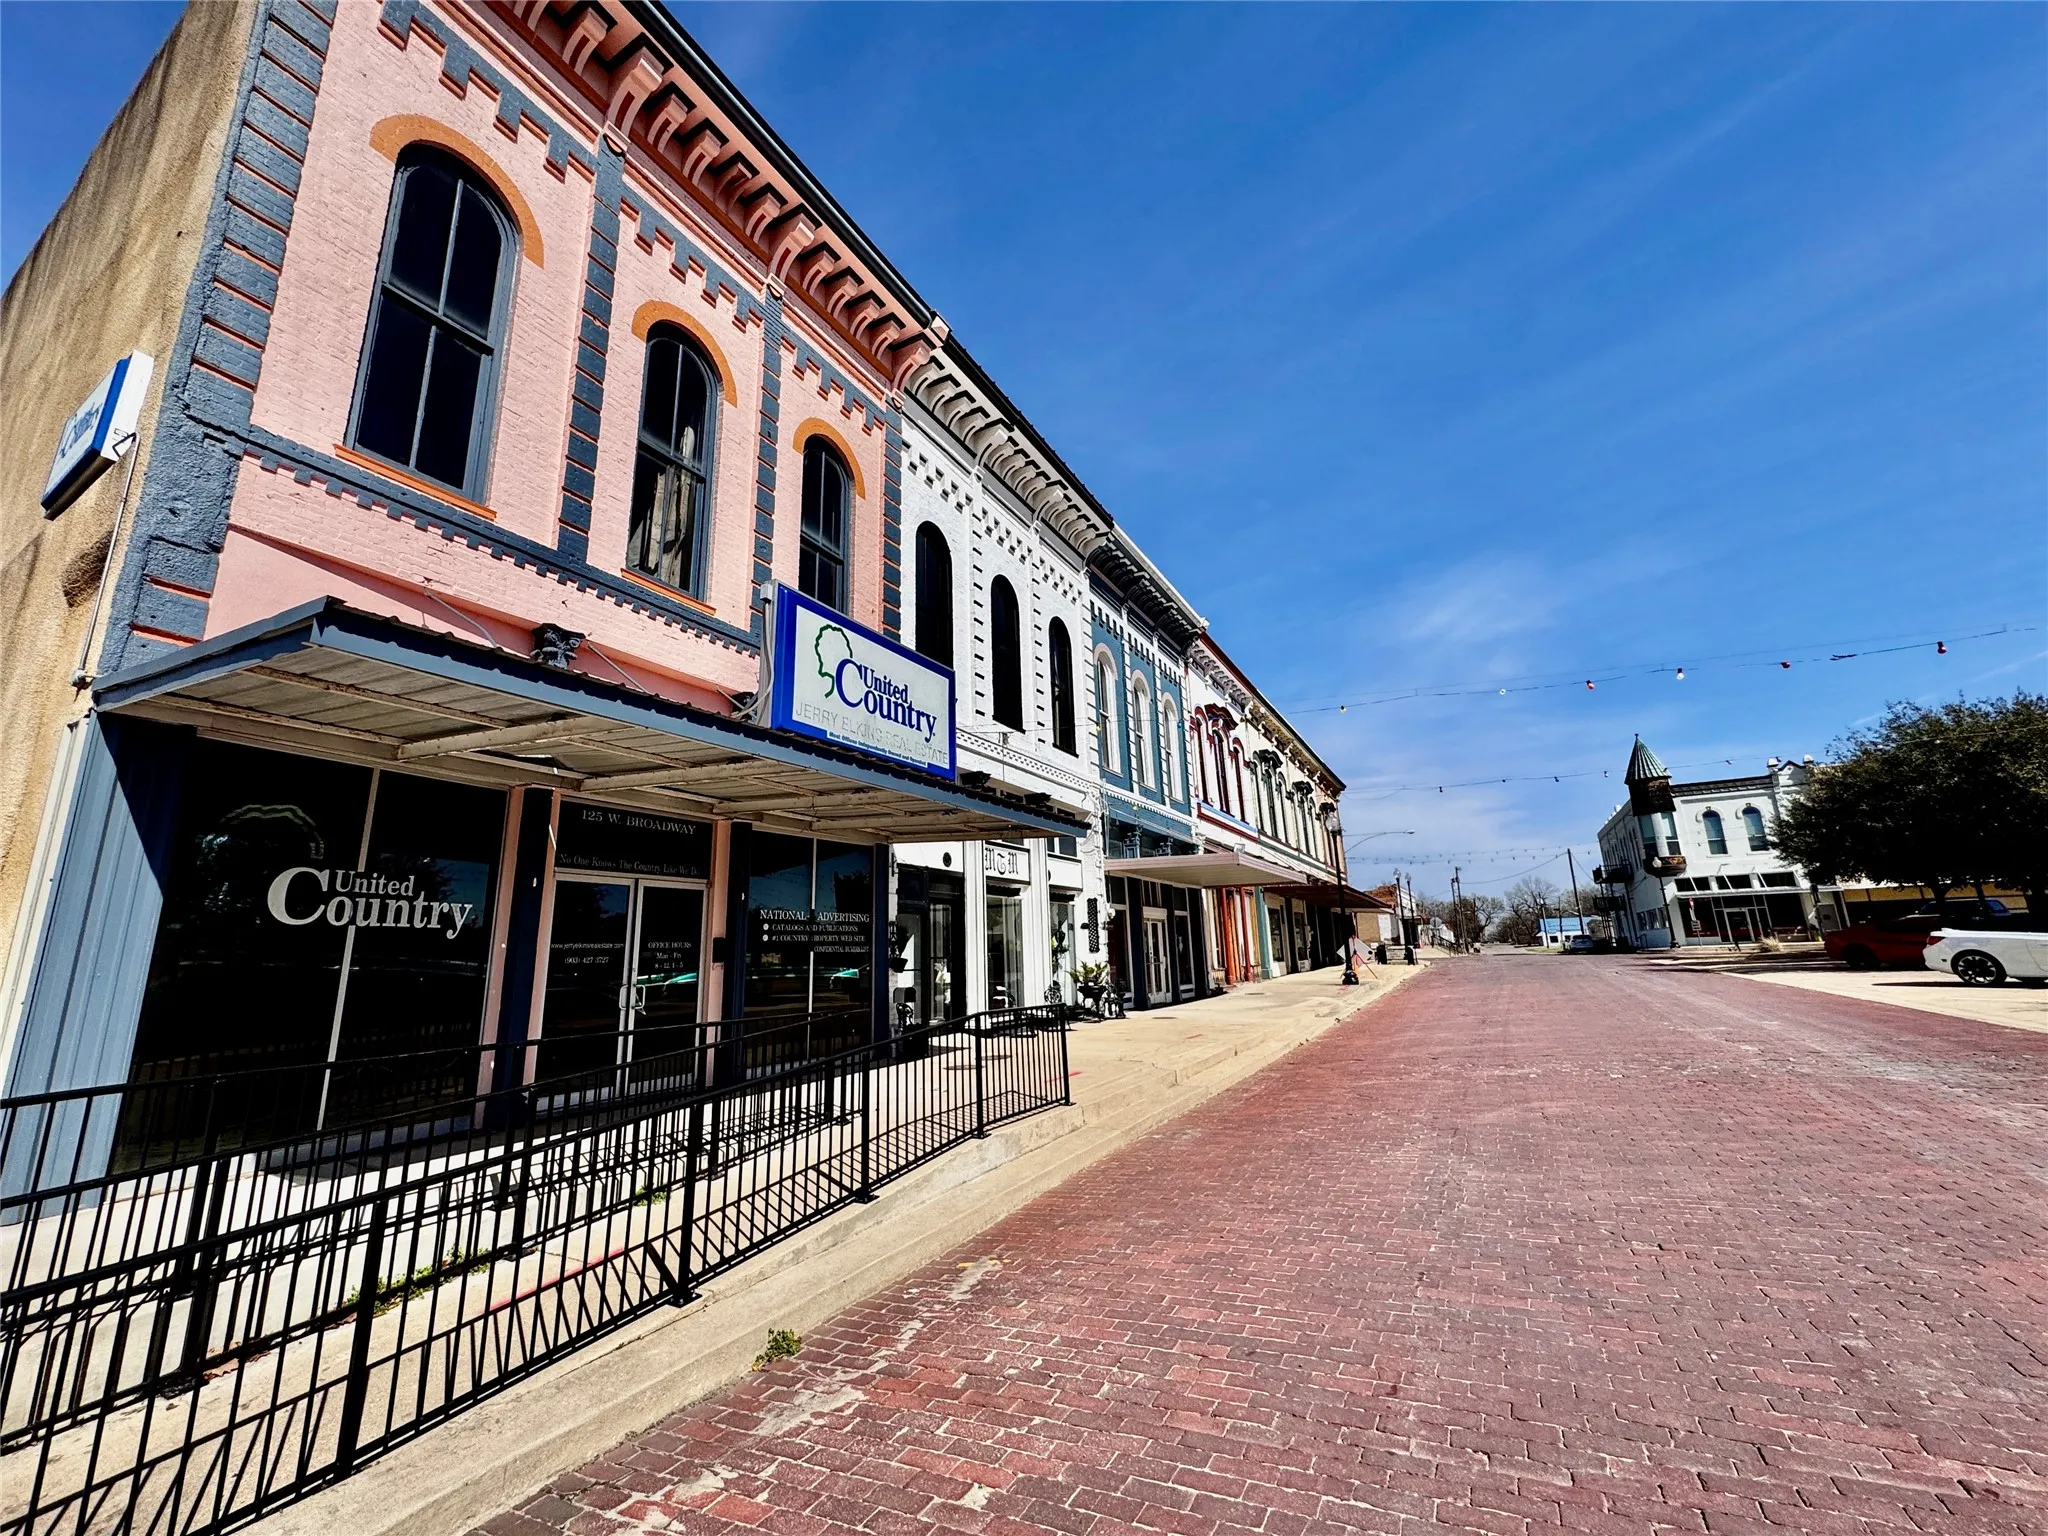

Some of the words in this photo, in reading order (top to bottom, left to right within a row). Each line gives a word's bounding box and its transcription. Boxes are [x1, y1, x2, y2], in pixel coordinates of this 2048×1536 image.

[862, 666, 909, 702] United
[835, 658, 937, 743] Country
[796, 702, 838, 726] JERRY
[841, 716, 883, 742] ELKINS
[885, 731, 913, 753] REAL
[915, 741, 948, 765] ESTATE
[581, 809, 604, 822] 125
[608, 812, 622, 825] W.
[626, 815, 697, 835] BROADWAY
[573, 854, 589, 866] One
[592, 856, 617, 868] Knows
[618, 859, 632, 870] The
[634, 861, 661, 874] Country
[663, 863, 678, 874] Like
[335, 868, 415, 897] United
[266, 866, 473, 940] Country
[760, 909, 808, 920] NATIONAL
[817, 911, 870, 923] ADVERTISING
[772, 923, 804, 932] CATALOGS
[818, 924, 859, 933] PUBLICATIONS
[780, 934, 809, 942] COUNTRY
